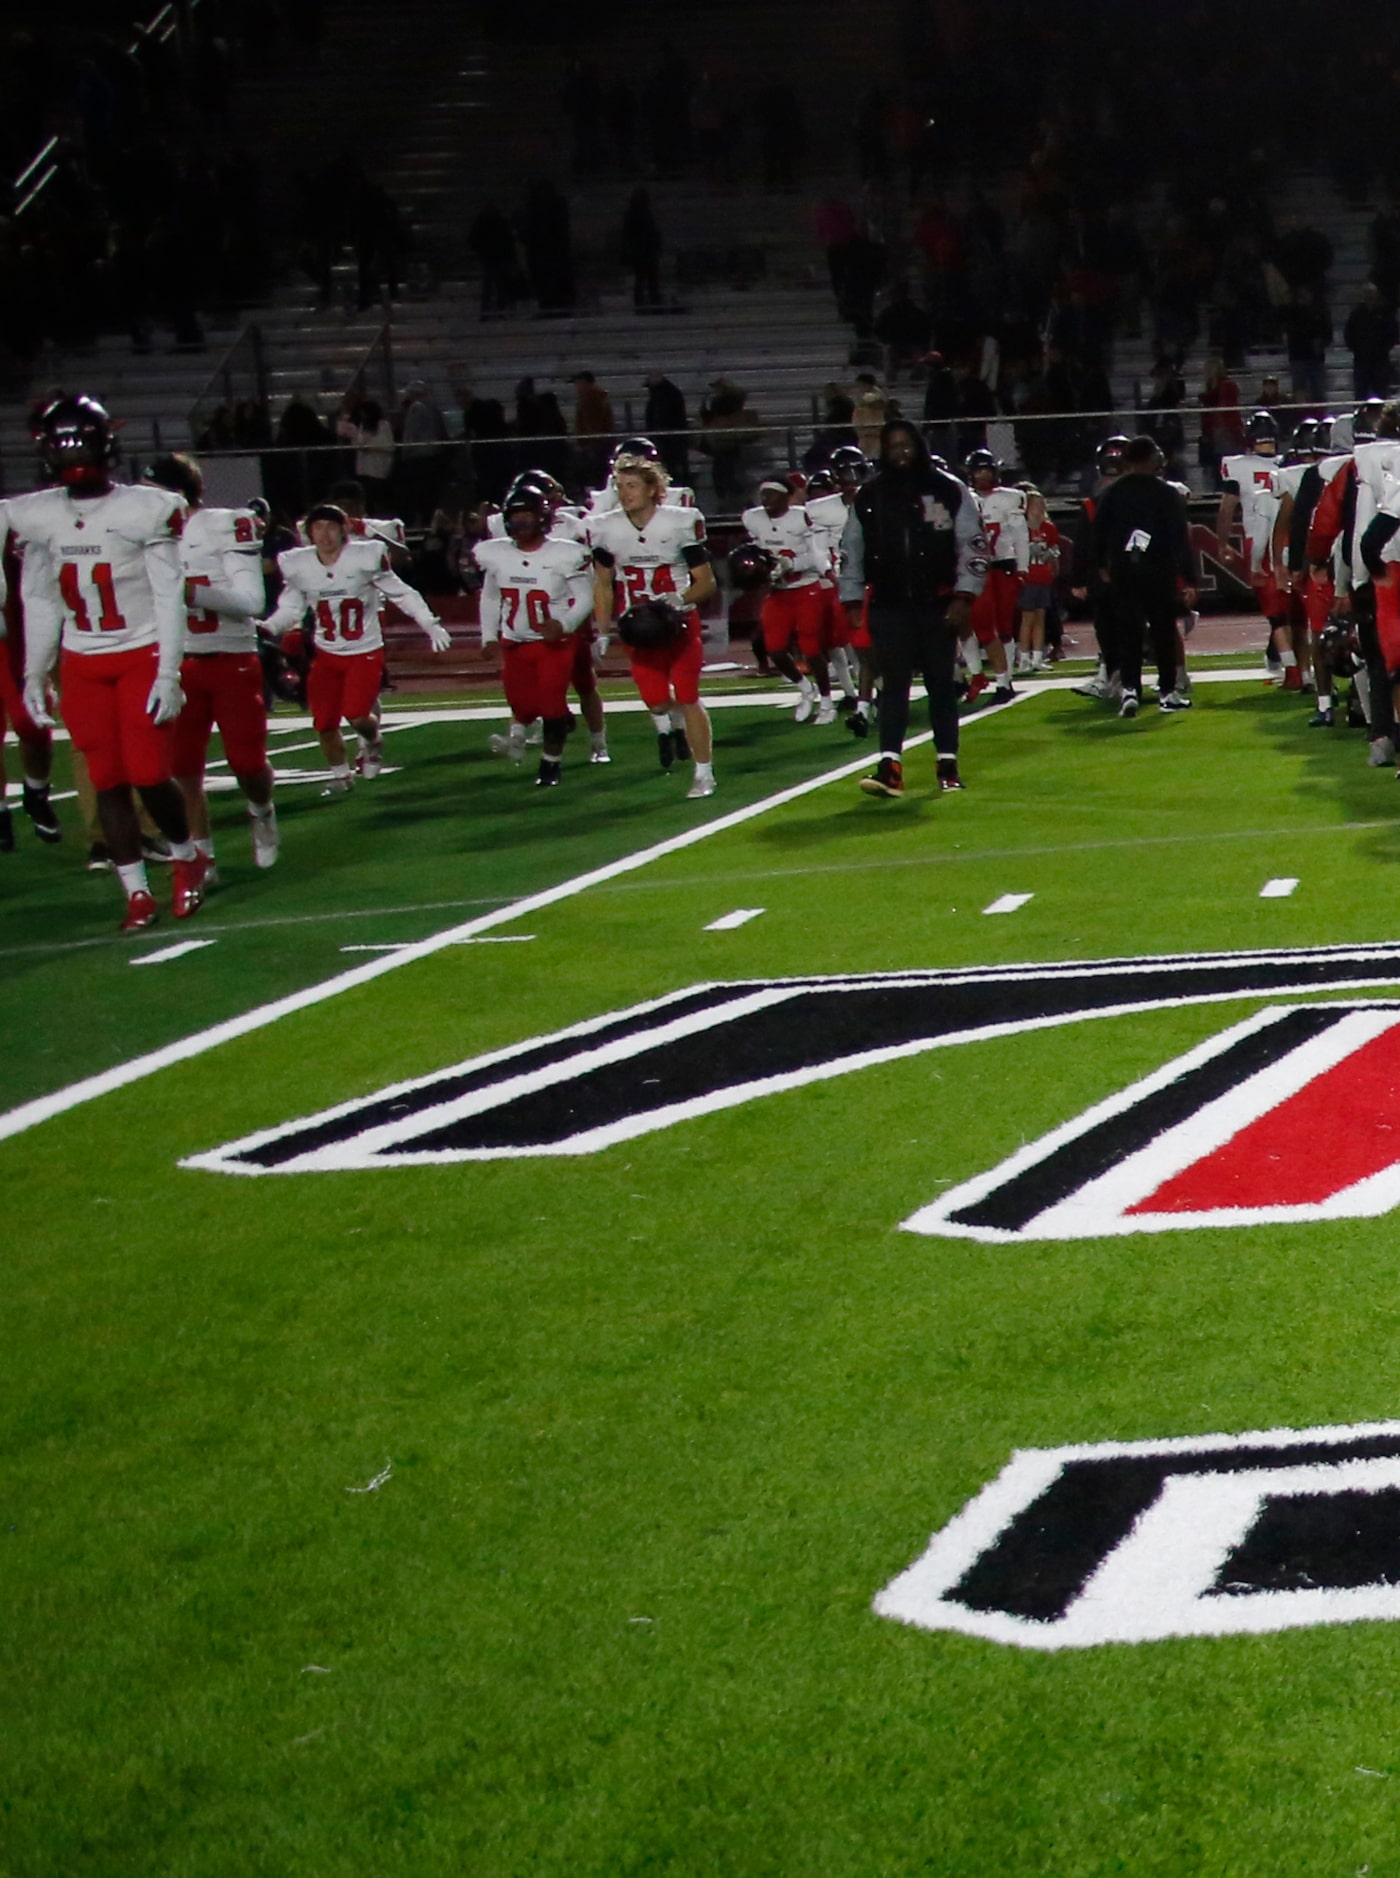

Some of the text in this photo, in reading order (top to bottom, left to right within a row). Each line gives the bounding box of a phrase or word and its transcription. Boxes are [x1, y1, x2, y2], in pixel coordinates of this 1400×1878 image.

[58, 562, 127, 633] 41
[621, 563, 677, 604] 24
[316, 598, 365, 642] 40
[500, 587, 551, 634] 70
